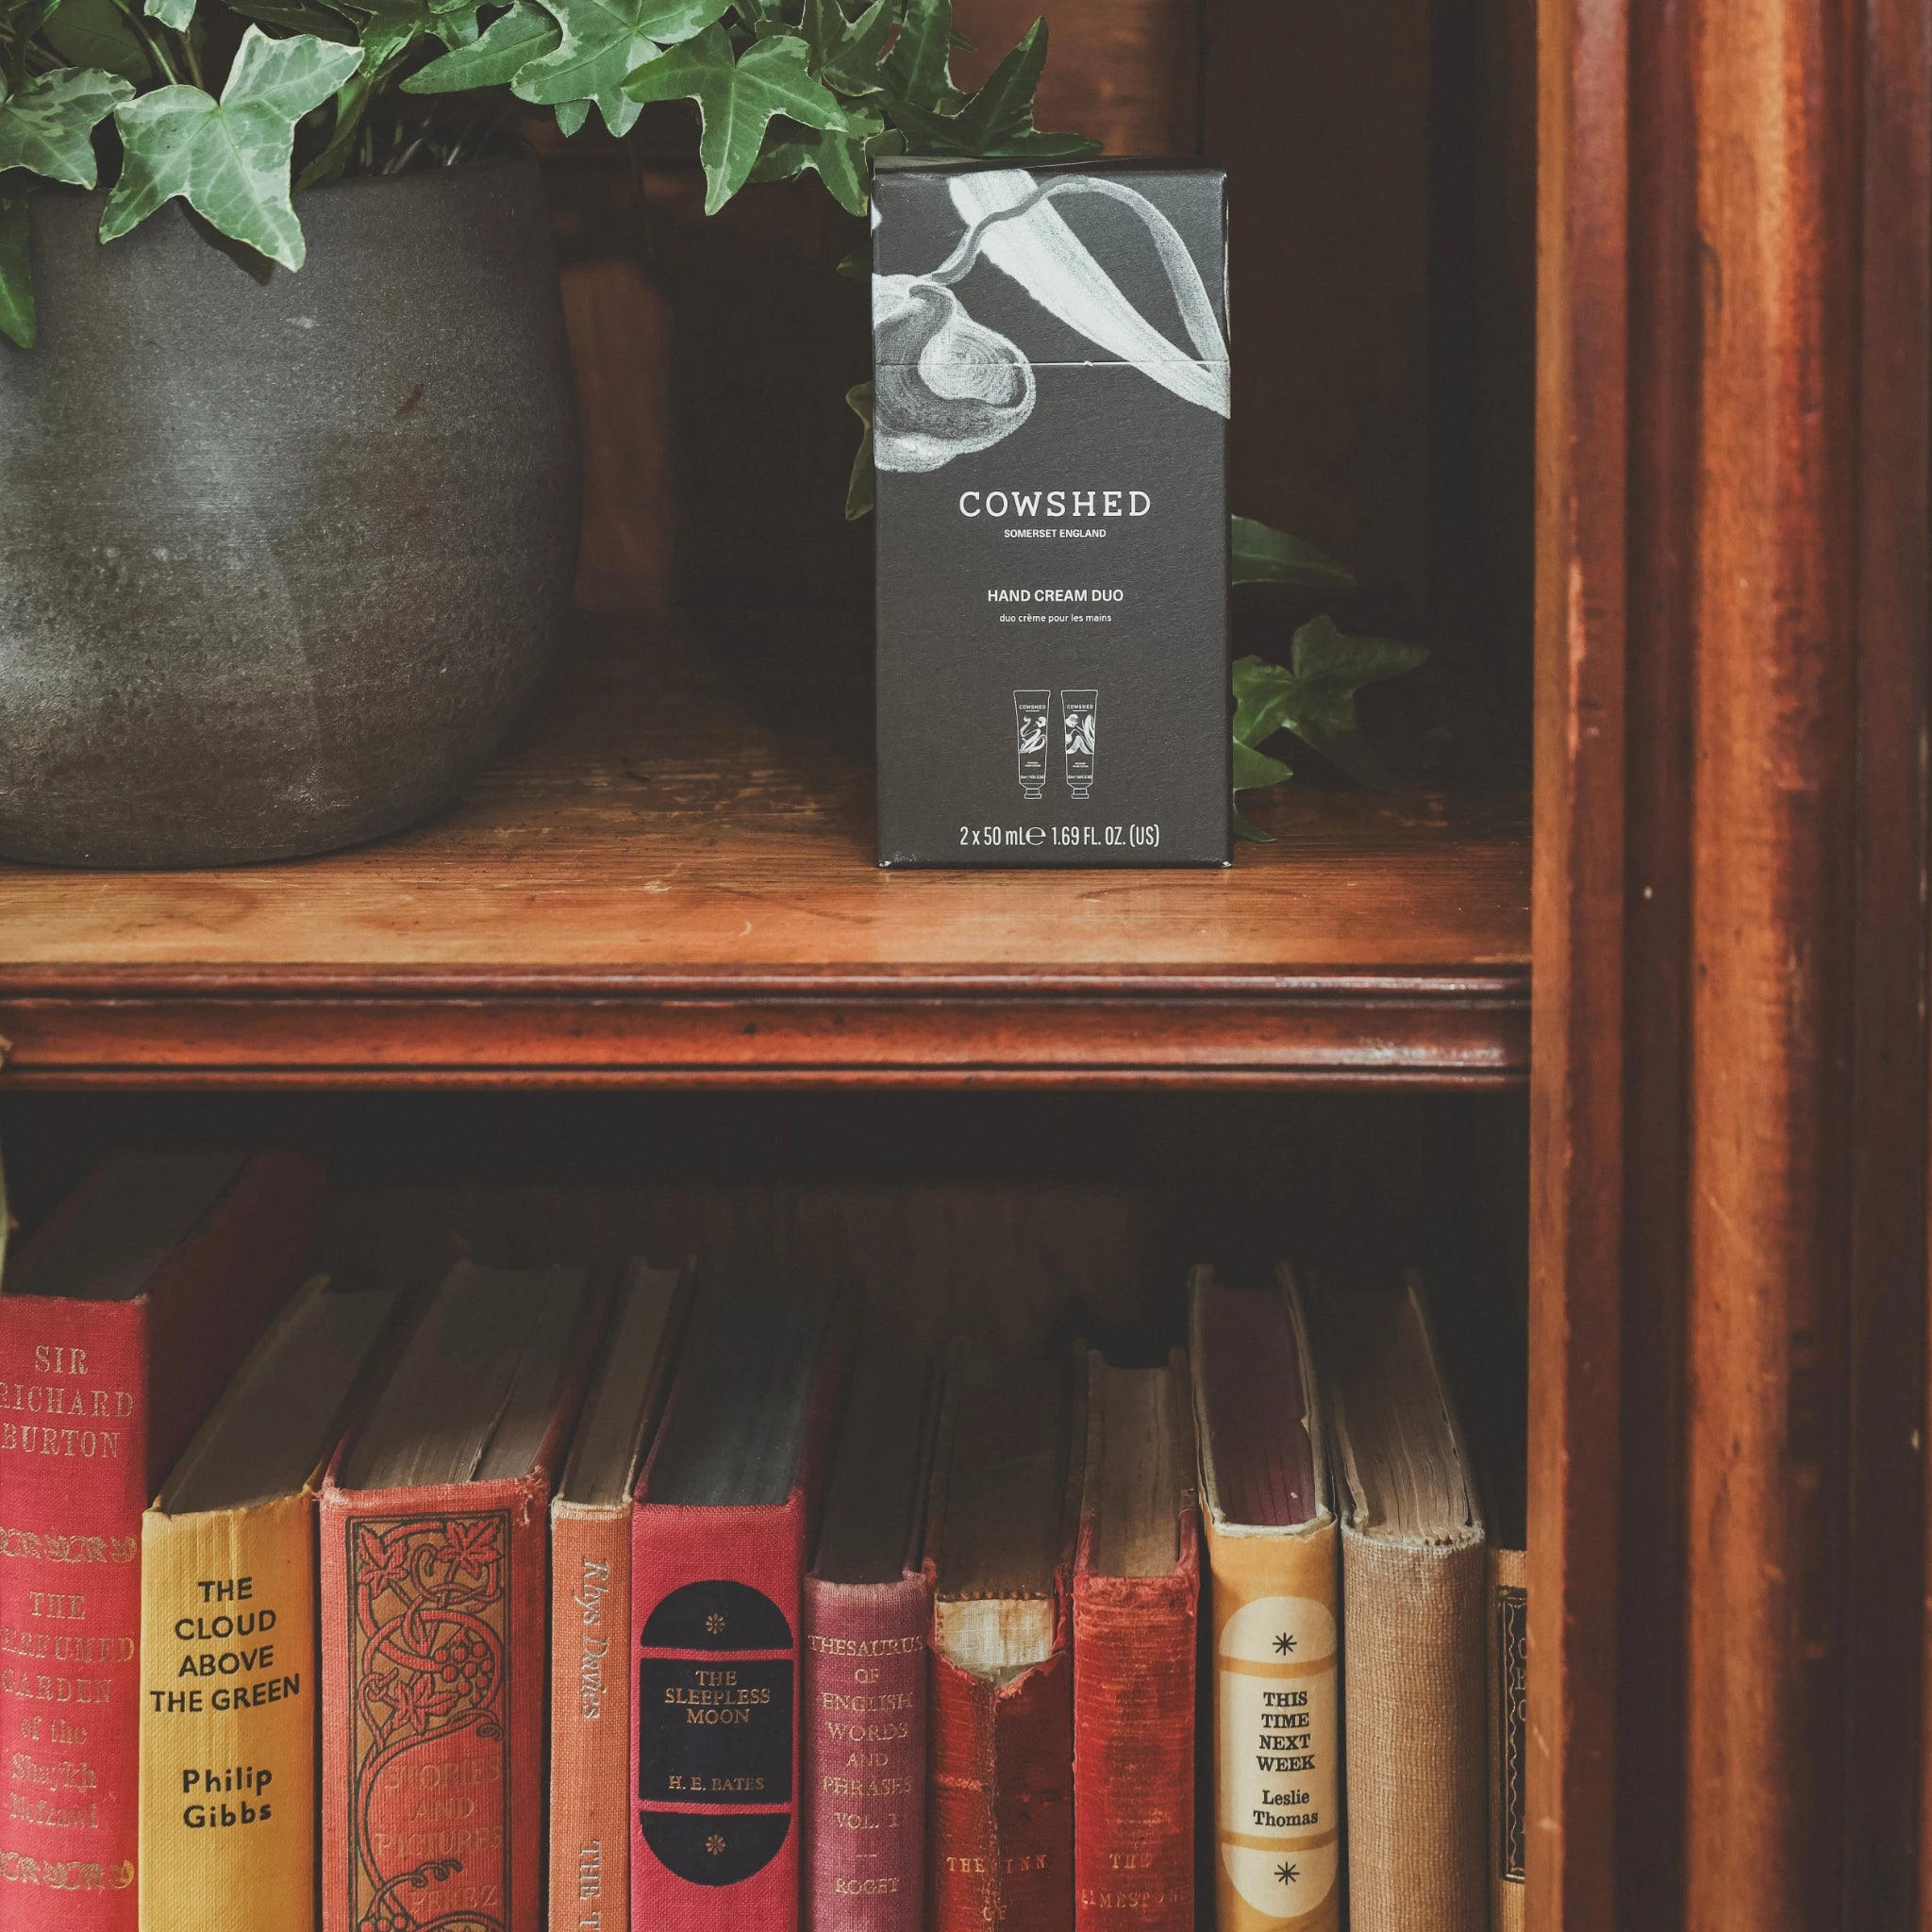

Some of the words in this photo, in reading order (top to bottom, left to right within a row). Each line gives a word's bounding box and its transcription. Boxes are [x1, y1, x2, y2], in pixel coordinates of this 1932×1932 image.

[959, 491, 1151, 518] COWSHED
[1004, 528, 1057, 539] SOMERSET
[1059, 528, 1107, 539] ENGLAND
[987, 589, 1031, 603] HAND
[1034, 589, 1088, 603] CREAM
[1091, 589, 1124, 603] DUO
[999, 613, 1016, 623] duo
[1018, 613, 1046, 623] crème
[1048, 615, 1069, 625] pour
[1071, 613, 1084, 623] les
[1085, 614, 1112, 623] mains
[959, 825, 969, 845] 2
[972, 830, 981, 845] x
[983, 825, 1002, 845] 50
[1051, 825, 1080, 845] 1.69
[1083, 825, 1102, 845] FL.
[1105, 825, 1126, 845] OZ.
[1129, 824, 1160, 847] (US)
[35, 1344, 89, 1374] SIR
[1, 1422, 121, 1458] BURTON
[198, 1575, 253, 1603] THE
[573, 1557, 609, 1626] Rhys
[30, 1591, 86, 1620] THE
[175, 1607, 277, 1641] CLOUD
[0, 1626, 135, 1663] ERFUMED
[808, 1634, 924, 1657] THESAURUS
[178, 1644, 275, 1678] ABOVE
[581, 1629, 609, 1720] Davies
[695, 1670, 738, 1687] THE
[854, 1667, 880, 1685] OF
[1, 1668, 113, 1704] GARDEN
[150, 1690, 204, 1714] THE
[210, 1673, 301, 1711] GREEN
[664, 1688, 771, 1706] SLEEPLESS
[821, 1691, 914, 1713] ENGLISH
[1262, 1690, 1309, 1707] THIS
[686, 1708, 751, 1724] MOON
[1260, 1711, 1310, 1729] TIME
[21, 1714, 42, 1742] of
[51, 1718, 89, 1745] the
[827, 1720, 908, 1742] WORDS
[1258, 1733, 1311, 1751] NEXT
[845, 1752, 890, 1768] AND
[1256, 1755, 1316, 1773] WEEK
[182, 1767, 273, 1796] Philip
[668, 1775, 686, 1790] H.
[691, 1776, 707, 1790] E.
[711, 1775, 765, 1791] BATES
[822, 1774, 914, 1798] PHRASES
[1261, 1789, 1310, 1807] Leslie
[183, 1800, 273, 1828] Gibbs
[835, 1811, 880, 1830] VOL.
[1253, 1809, 1319, 1828] Thomas
[579, 1839, 602, 1901] THE
[946, 1856, 986, 1874] THE
[1006, 1854, 1047, 1874] INN
[1108, 1852, 1156, 1870] THE
[834, 1876, 901, 1896] ROGET
